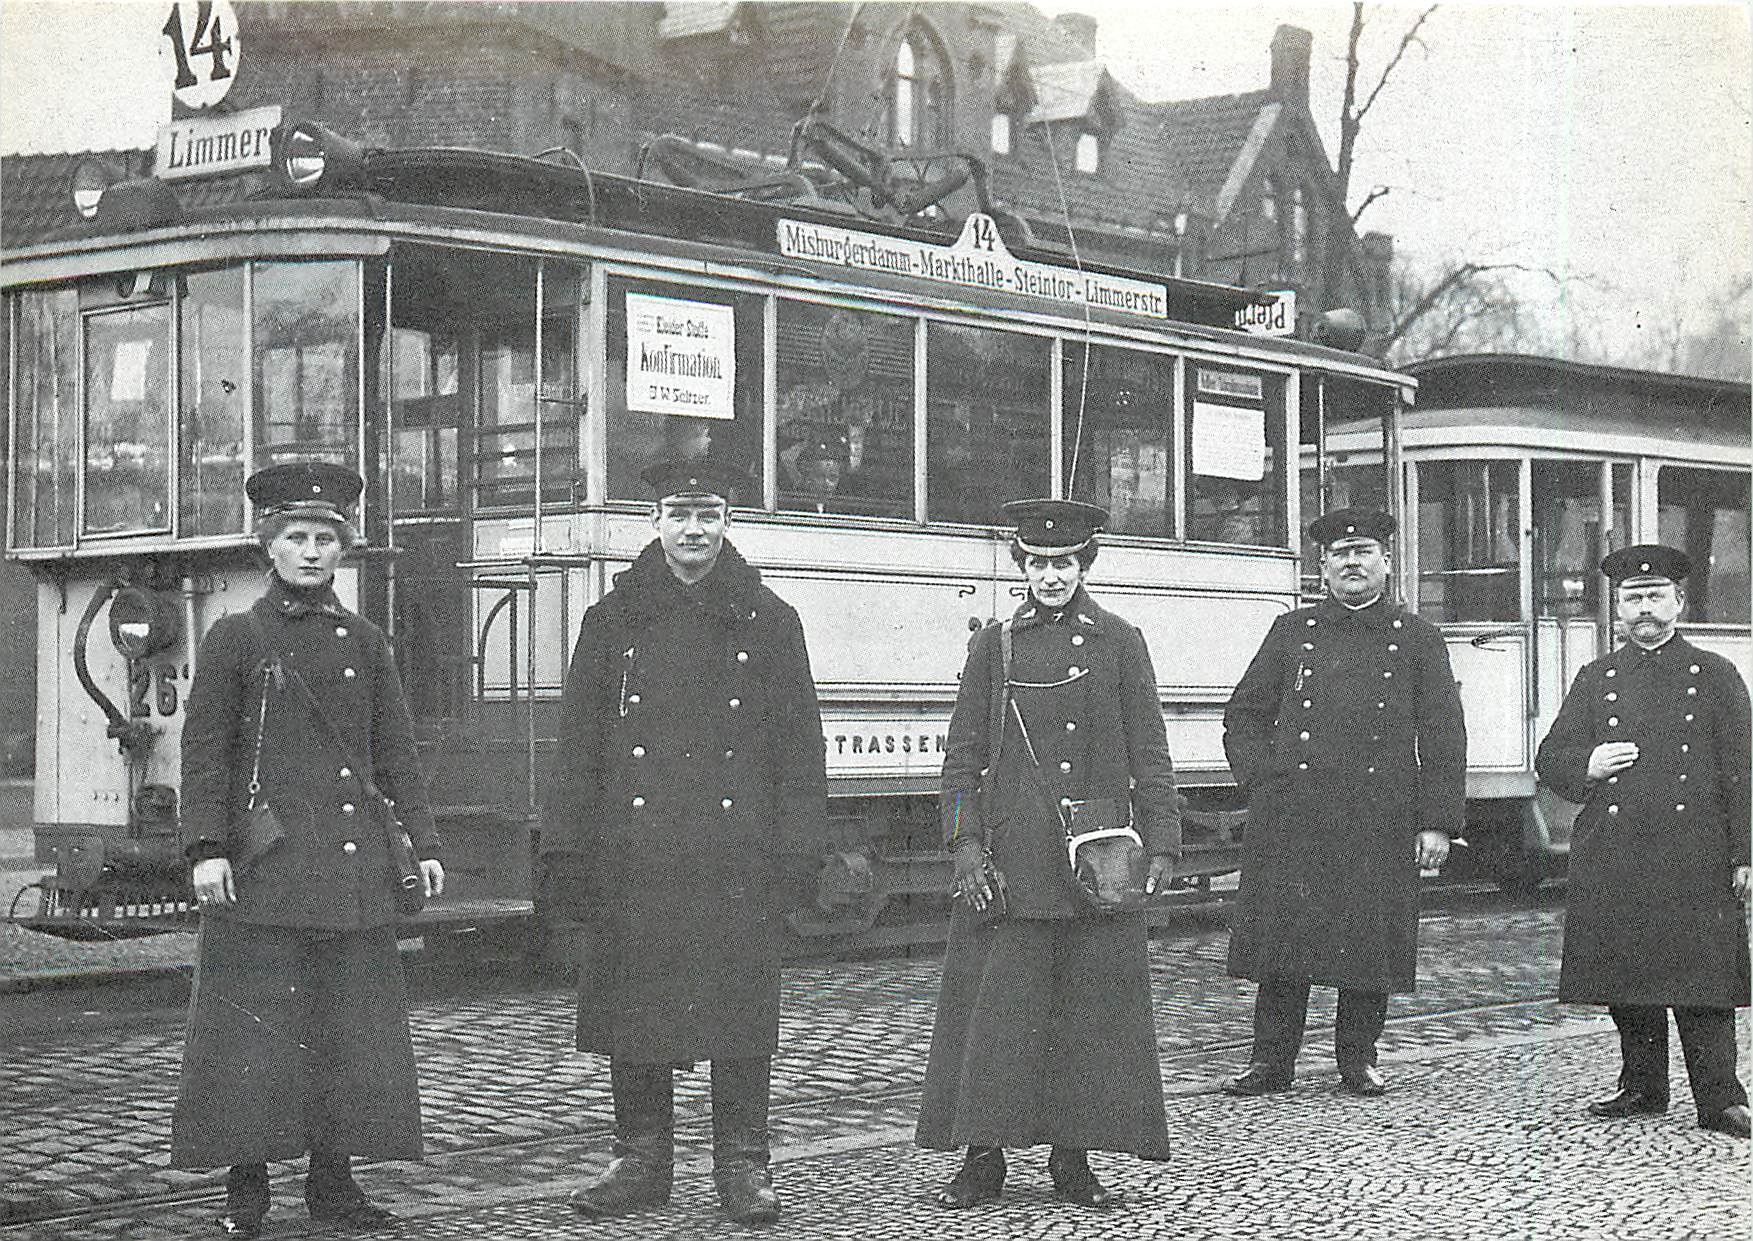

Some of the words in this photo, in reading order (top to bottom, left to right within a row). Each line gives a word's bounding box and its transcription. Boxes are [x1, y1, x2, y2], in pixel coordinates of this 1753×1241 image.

[162, 1, 232, 90] 14
[974, 216, 996, 251] 14
[825, 734, 946, 754] TRASSEN
